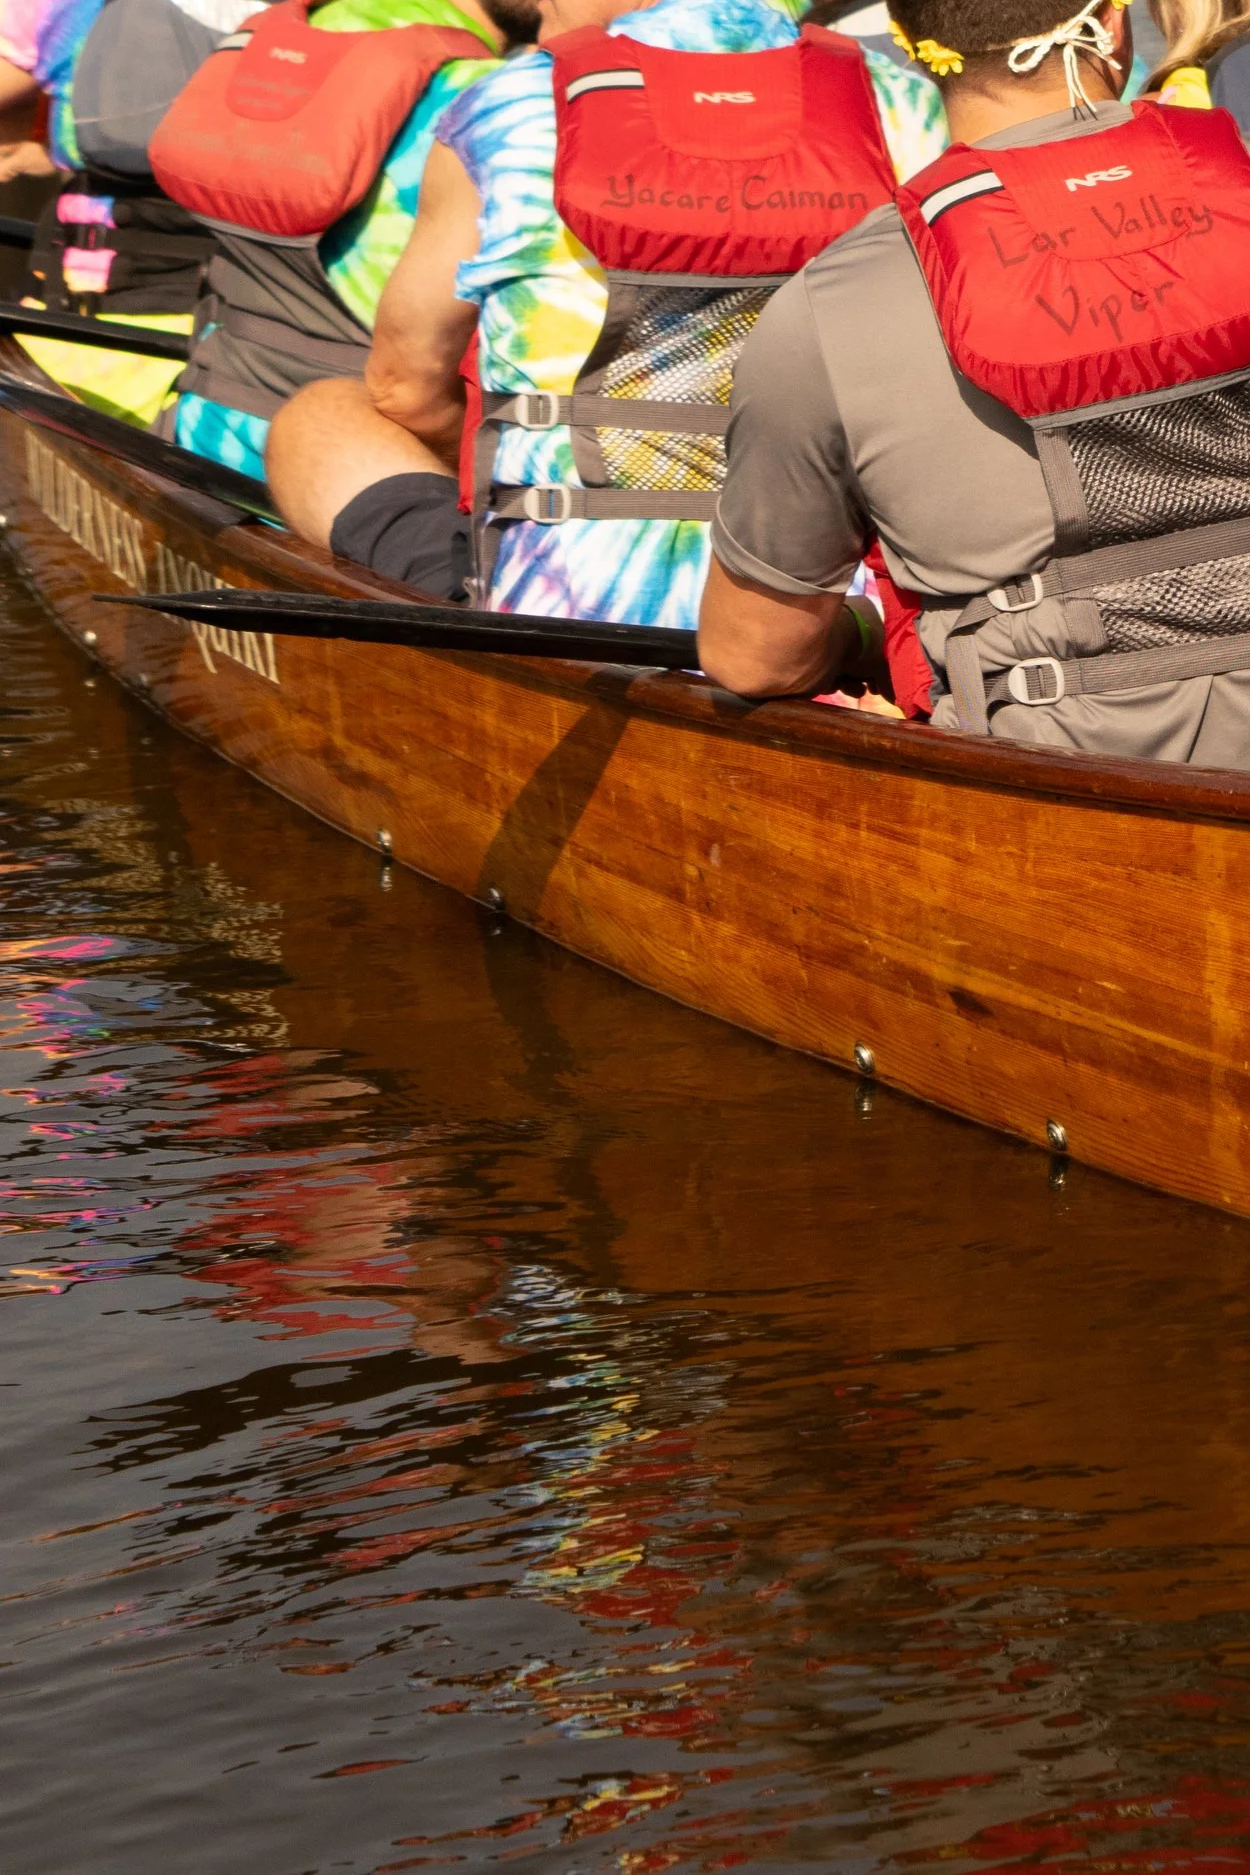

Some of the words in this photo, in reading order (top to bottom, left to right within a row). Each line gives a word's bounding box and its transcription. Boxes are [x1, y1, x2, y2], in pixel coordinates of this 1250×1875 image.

[693, 91, 756, 104] NRS
[601, 173, 731, 213] Yacare
[740, 174, 869, 212] Caiman
[1064, 164, 1133, 193] NRS
[987, 224, 1076, 269] Lar
[1090, 192, 1215, 241] Valley
[1033, 276, 1175, 343] Viper
